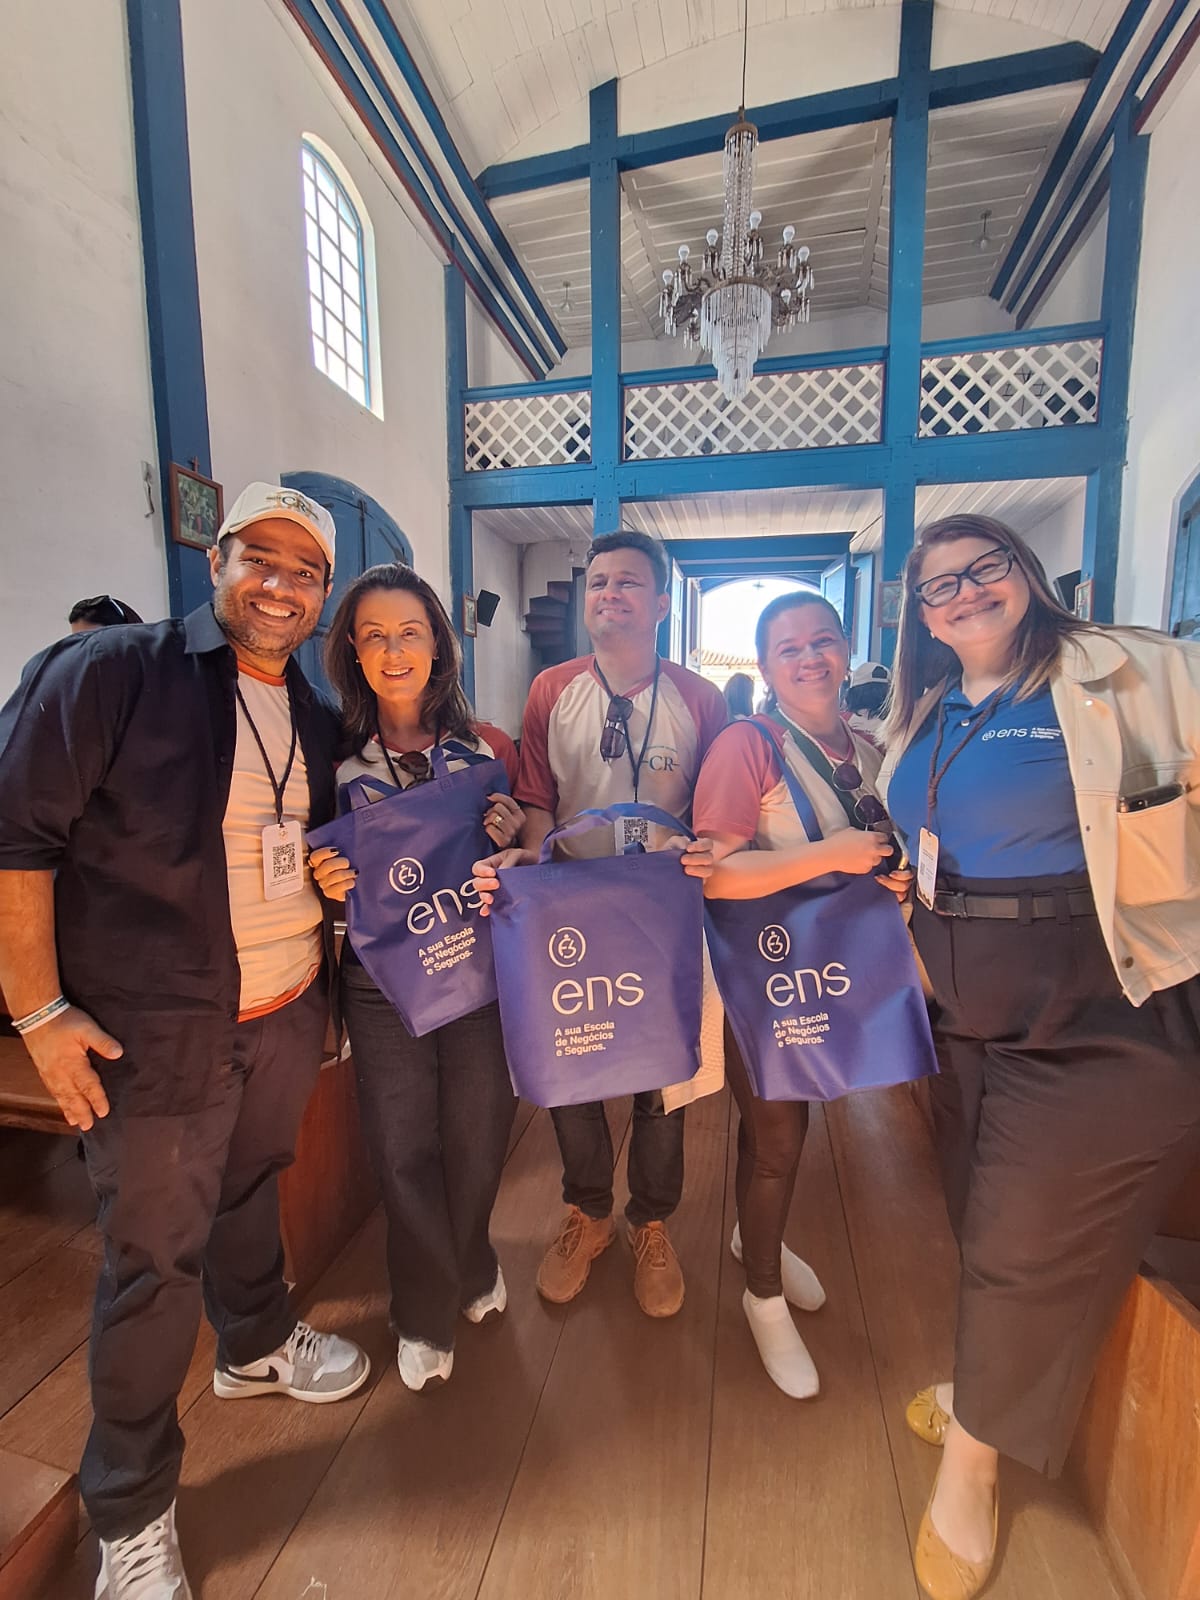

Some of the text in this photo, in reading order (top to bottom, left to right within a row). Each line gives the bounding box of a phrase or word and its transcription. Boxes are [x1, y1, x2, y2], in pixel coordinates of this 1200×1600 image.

[997, 728, 1028, 738] ens
[649, 755, 673, 772] CR
[418, 926, 475, 958] A sua Escola
[422, 936, 477, 967] de Negócios
[426, 950, 473, 976] e Seguros.
[766, 962, 851, 1007] ens
[552, 972, 645, 1015] ens
[554, 1021, 615, 1037] A sua Escola
[773, 1012, 829, 1030] A sua Escola
[555, 1031, 614, 1047] de Negócios
[775, 1023, 830, 1039] de Negócios
[556, 1043, 606, 1057] e Seguros.
